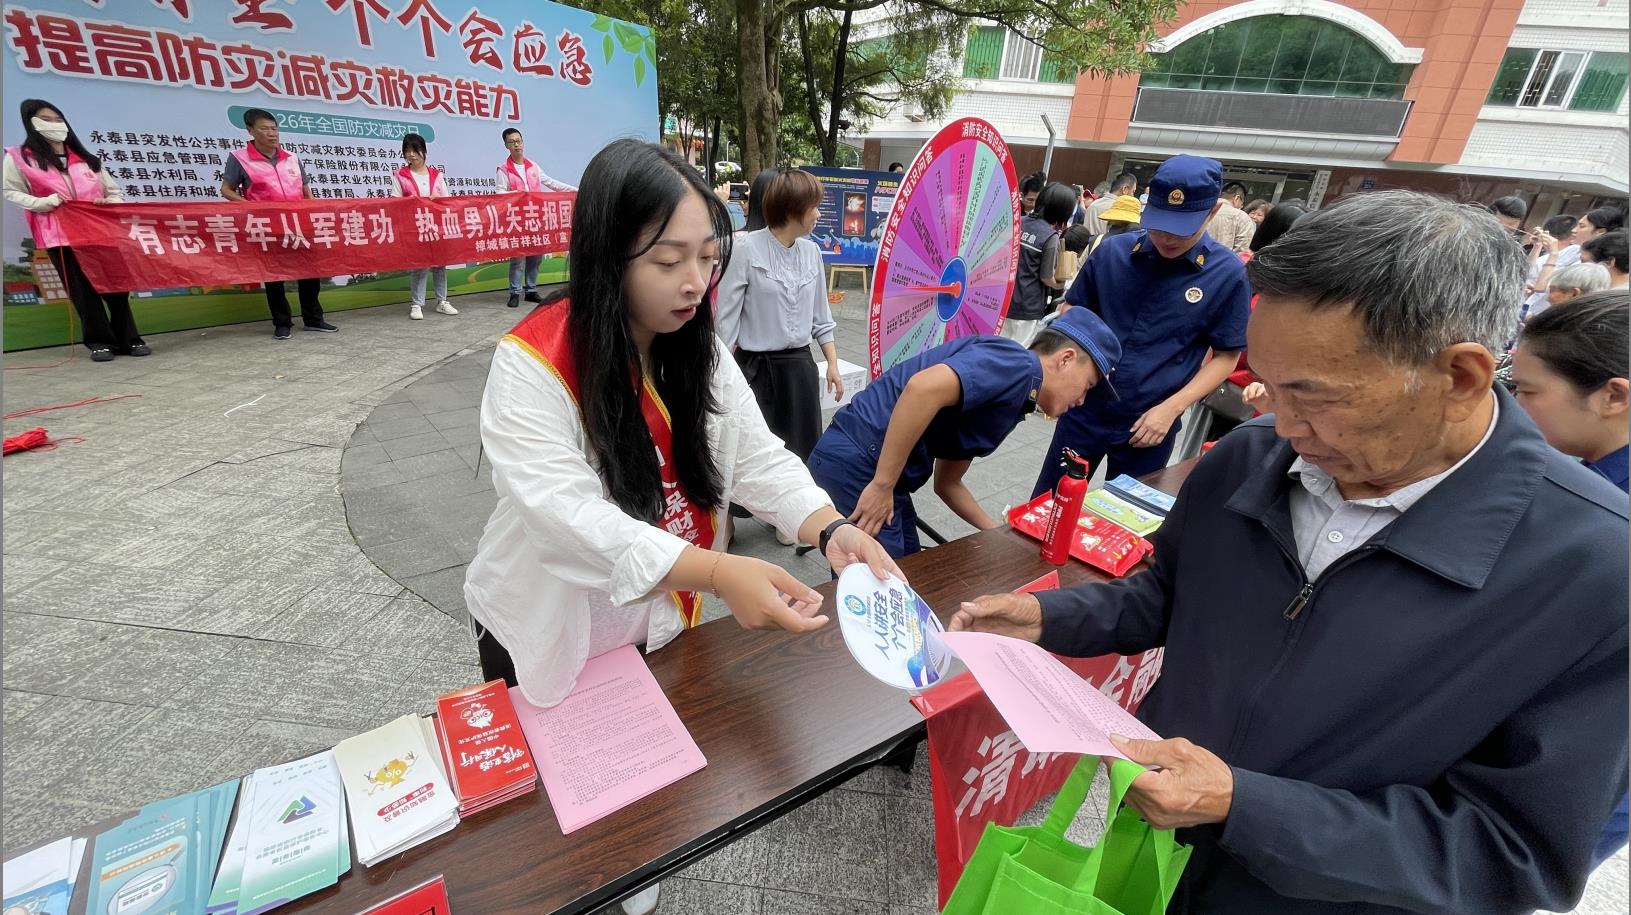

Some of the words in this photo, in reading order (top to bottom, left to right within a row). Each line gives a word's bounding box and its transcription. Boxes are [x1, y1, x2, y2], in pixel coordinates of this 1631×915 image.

[5, 10, 520, 120] 提高防灾减灾救灾能力
[90, 130, 245, 150] 永泰县突发性公共事件
[281, 142, 405, 159] 防灾减灾救灾委员会办公
[962, 121, 1008, 164] 消防安全知识问答
[121, 184, 219, 198] 泰县住房和城
[444, 177, 496, 187] 资源和规划局
[881, 146, 934, 262] 消防安全知识问答
[121, 208, 394, 256] 有志青年从军建功
[415, 200, 573, 243] 热血男儿矢志报国
[871, 303, 882, 378] 全知识问答
[874, 591, 890, 661] 人人讲安全
[889, 587, 907, 651] 个个会应急
